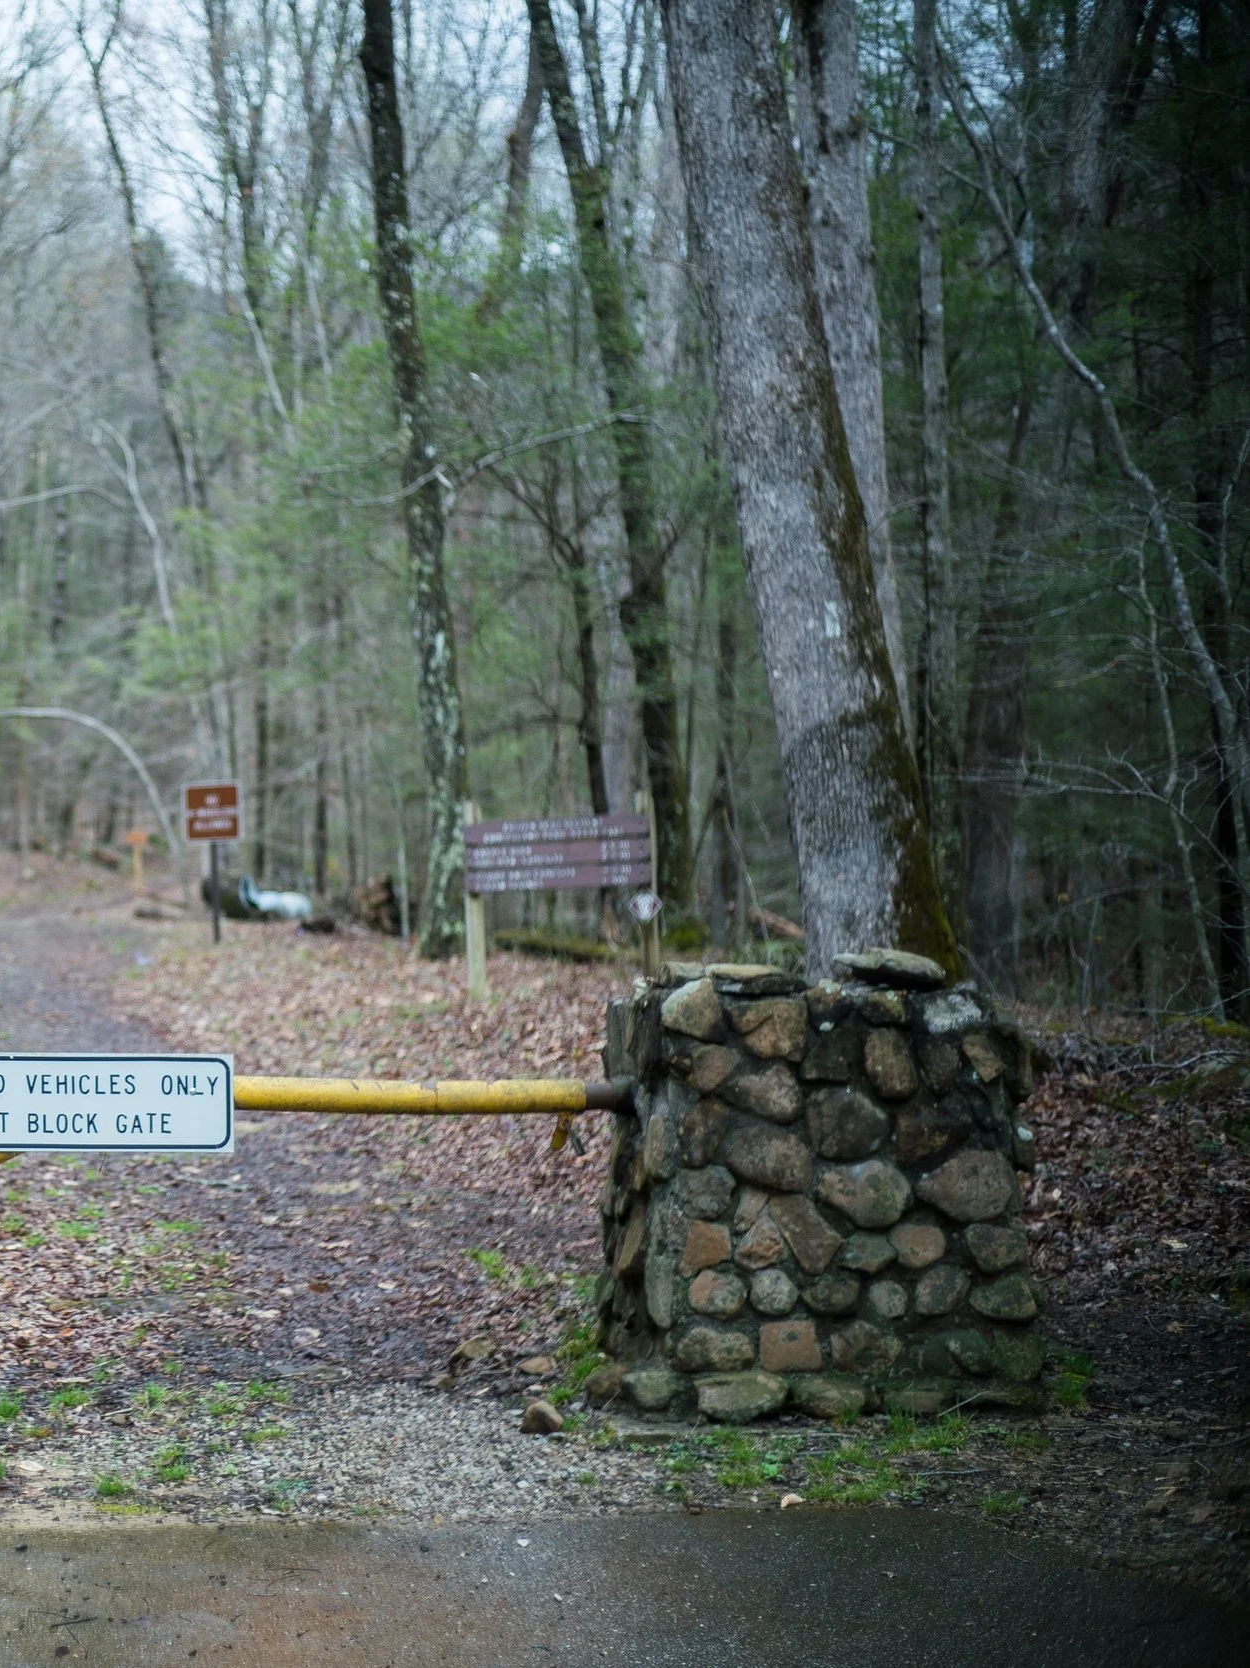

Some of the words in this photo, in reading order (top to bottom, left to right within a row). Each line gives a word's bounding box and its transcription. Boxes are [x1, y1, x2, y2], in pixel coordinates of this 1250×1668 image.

[26, 1075, 136, 1095] VEHICLES
[161, 1075, 219, 1096] ONLY
[27, 1112, 98, 1134] BLOCK
[115, 1112, 172, 1134] GATE
